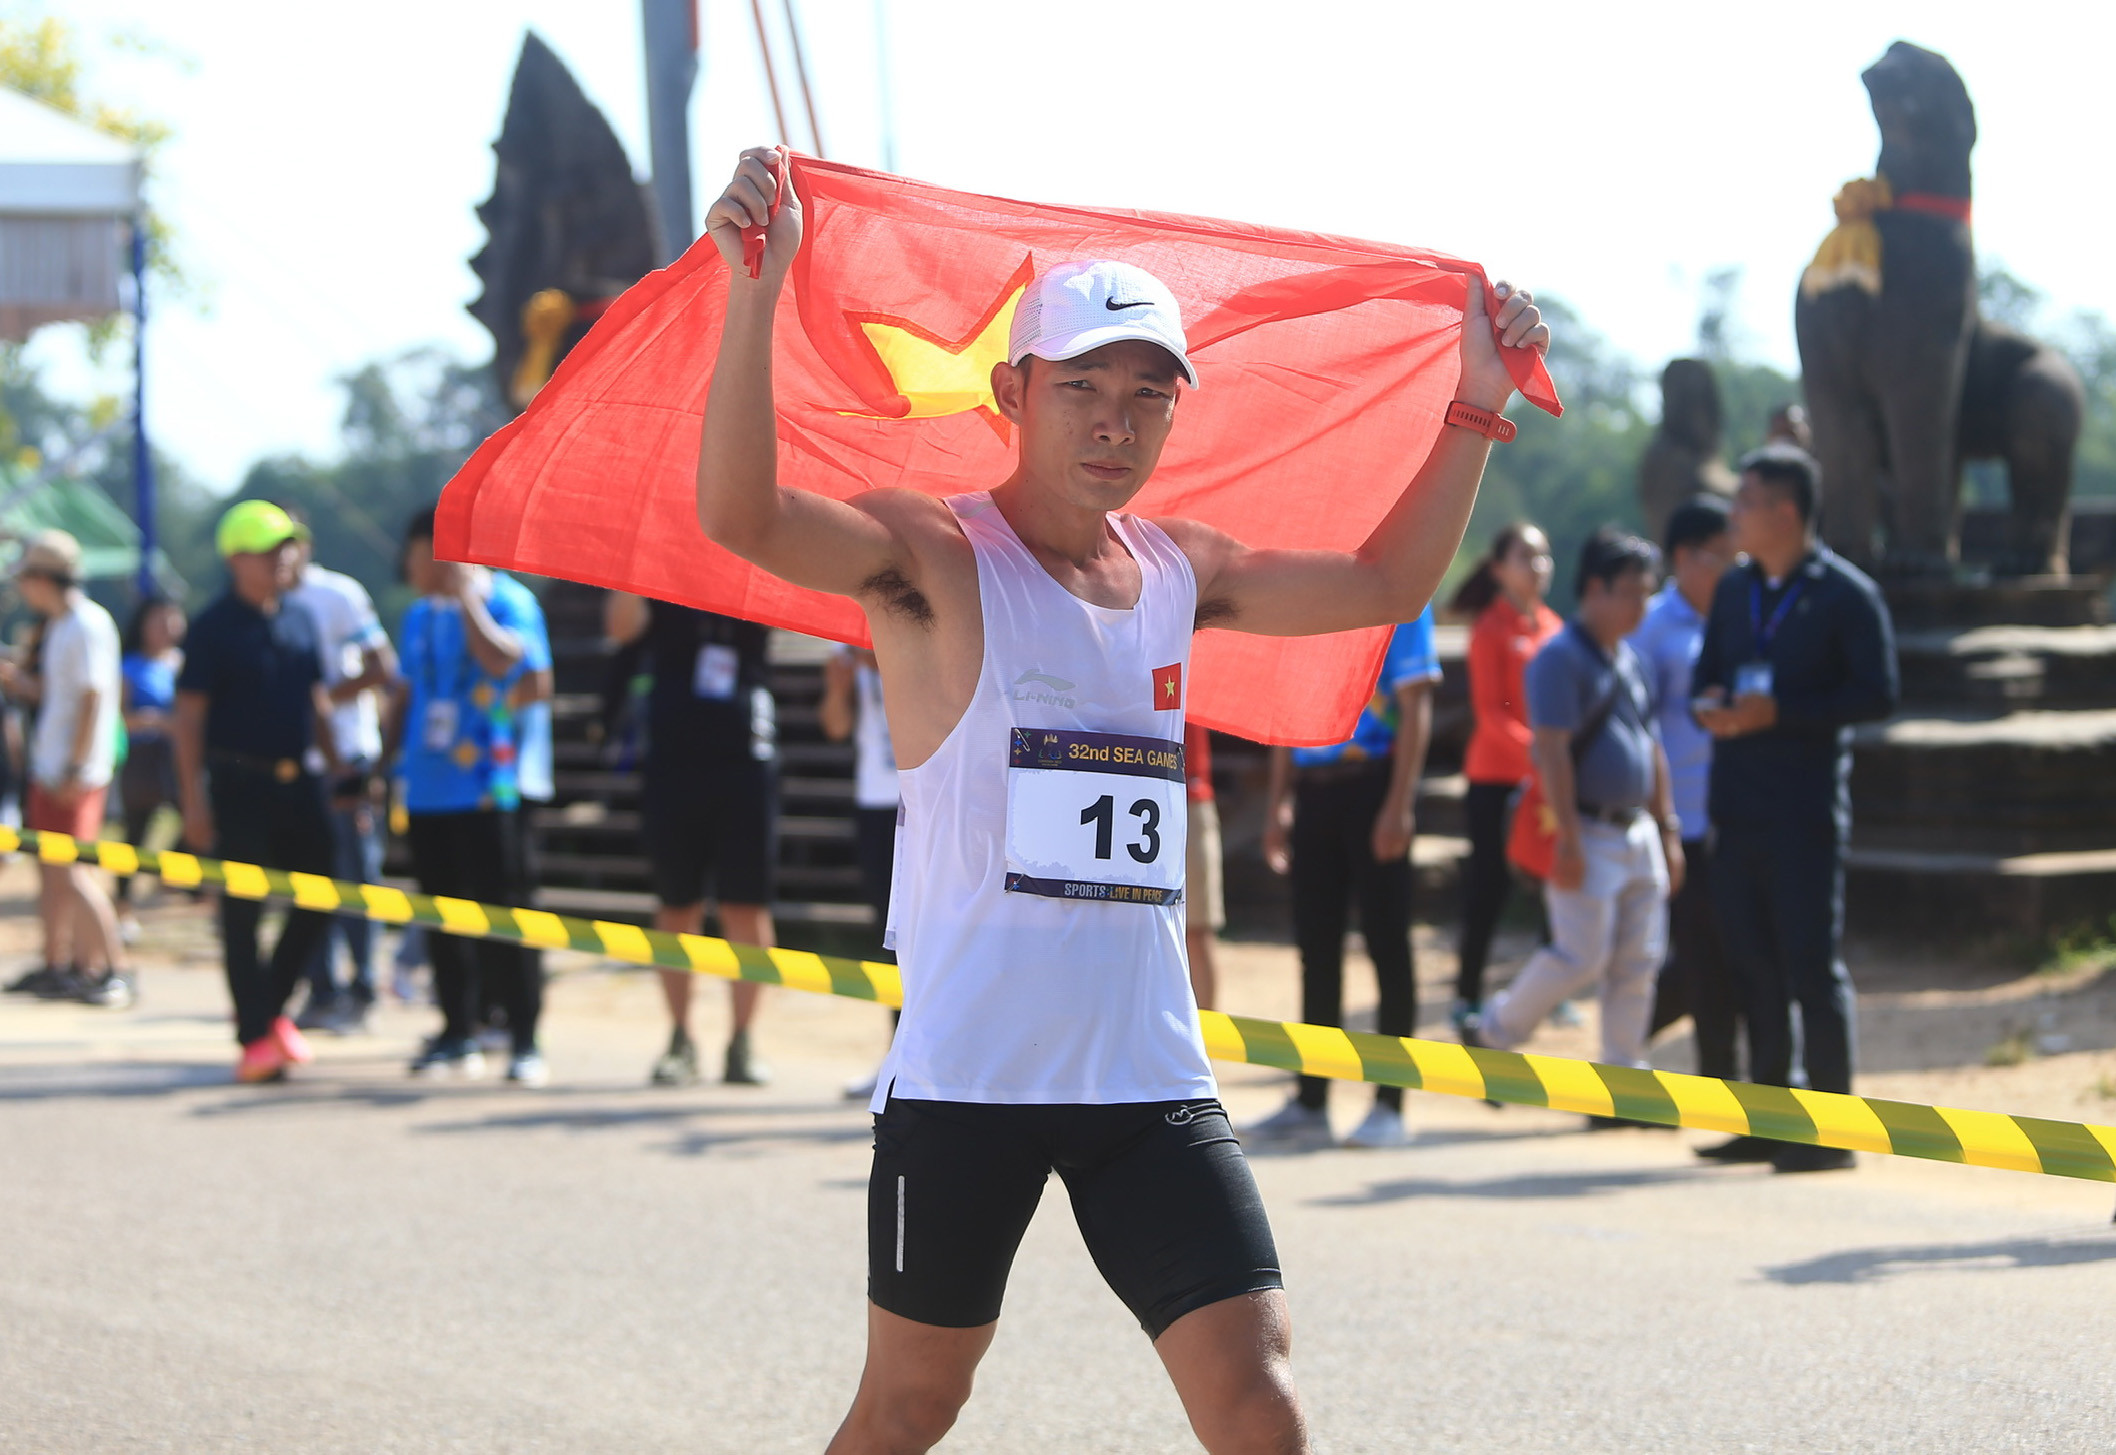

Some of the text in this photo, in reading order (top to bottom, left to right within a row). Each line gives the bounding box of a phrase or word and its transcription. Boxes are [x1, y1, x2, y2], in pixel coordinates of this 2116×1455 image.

[1068, 743, 1178, 770] 32nd SEA GAMES
[1080, 795, 1160, 864] 13
[1110, 886, 1130, 900] LIVE
[1132, 887, 1141, 900] IN
